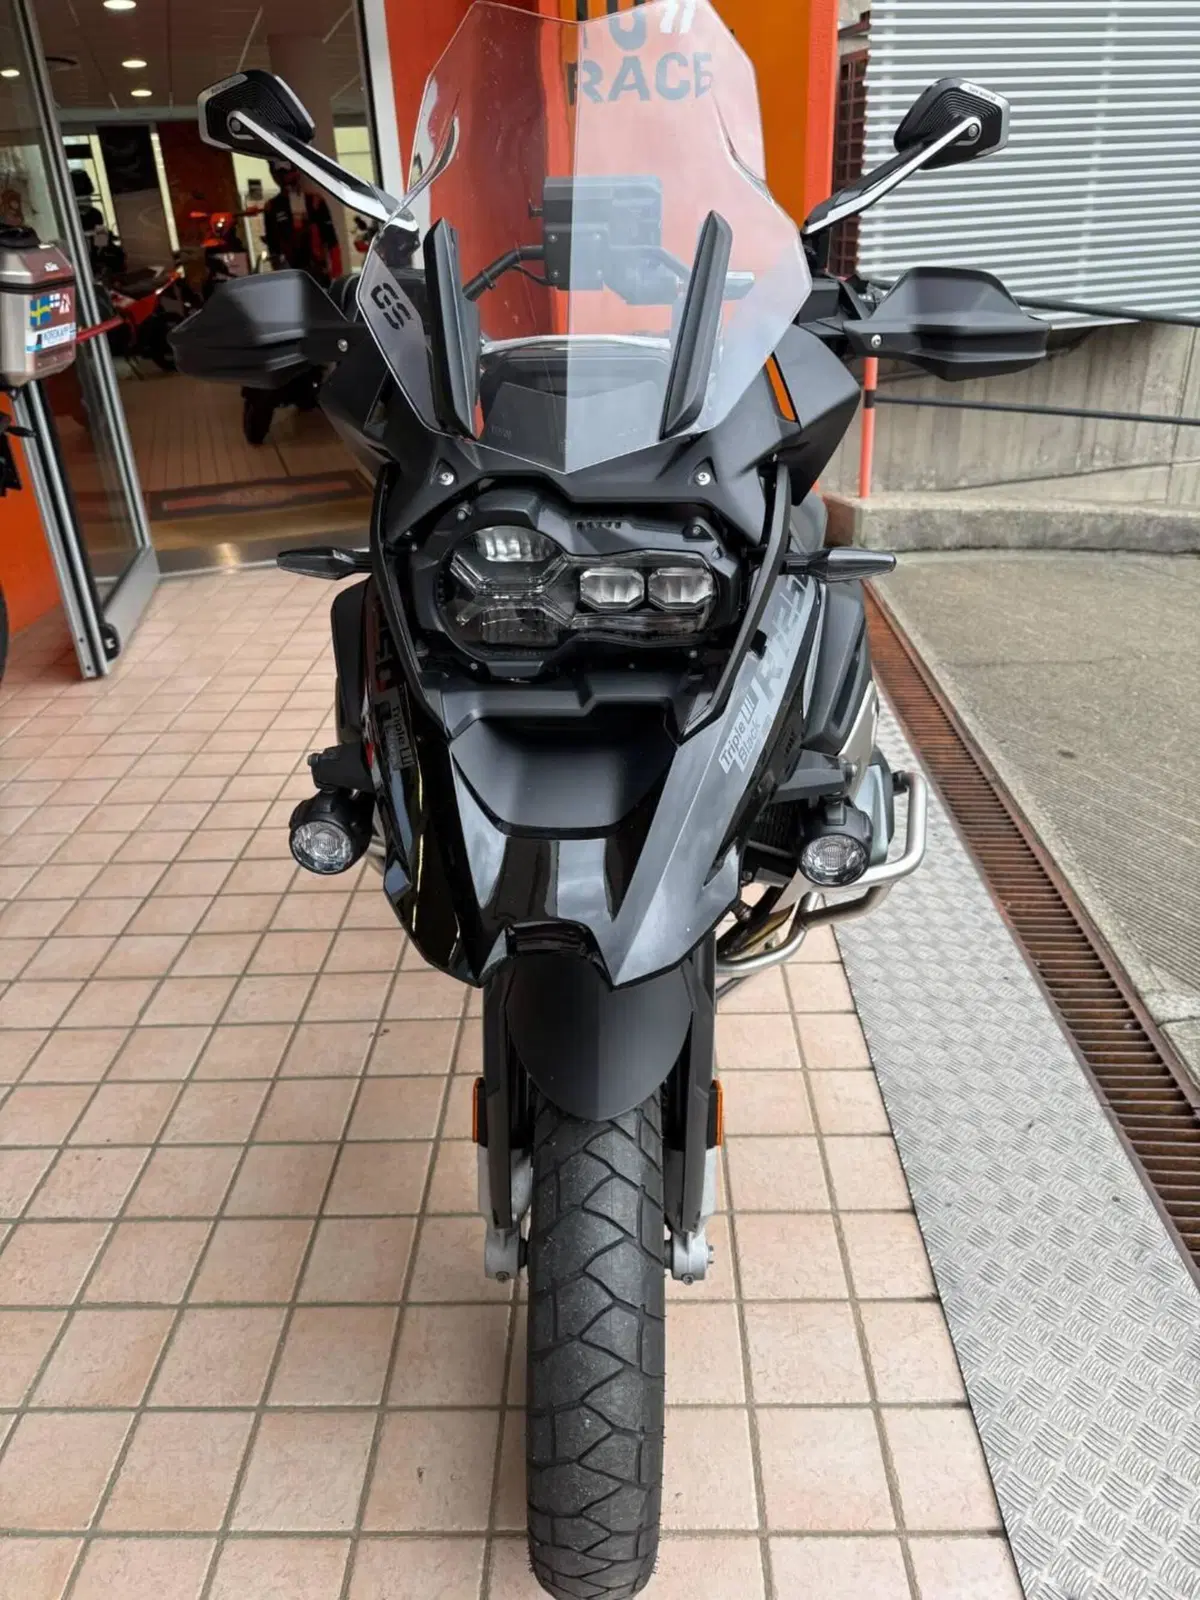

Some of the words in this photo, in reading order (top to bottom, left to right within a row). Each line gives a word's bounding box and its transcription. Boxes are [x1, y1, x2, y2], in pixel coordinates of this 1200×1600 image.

[371, 283, 412, 329] GS
[721, 721, 746, 767] Triple
[738, 720, 761, 766] Black
